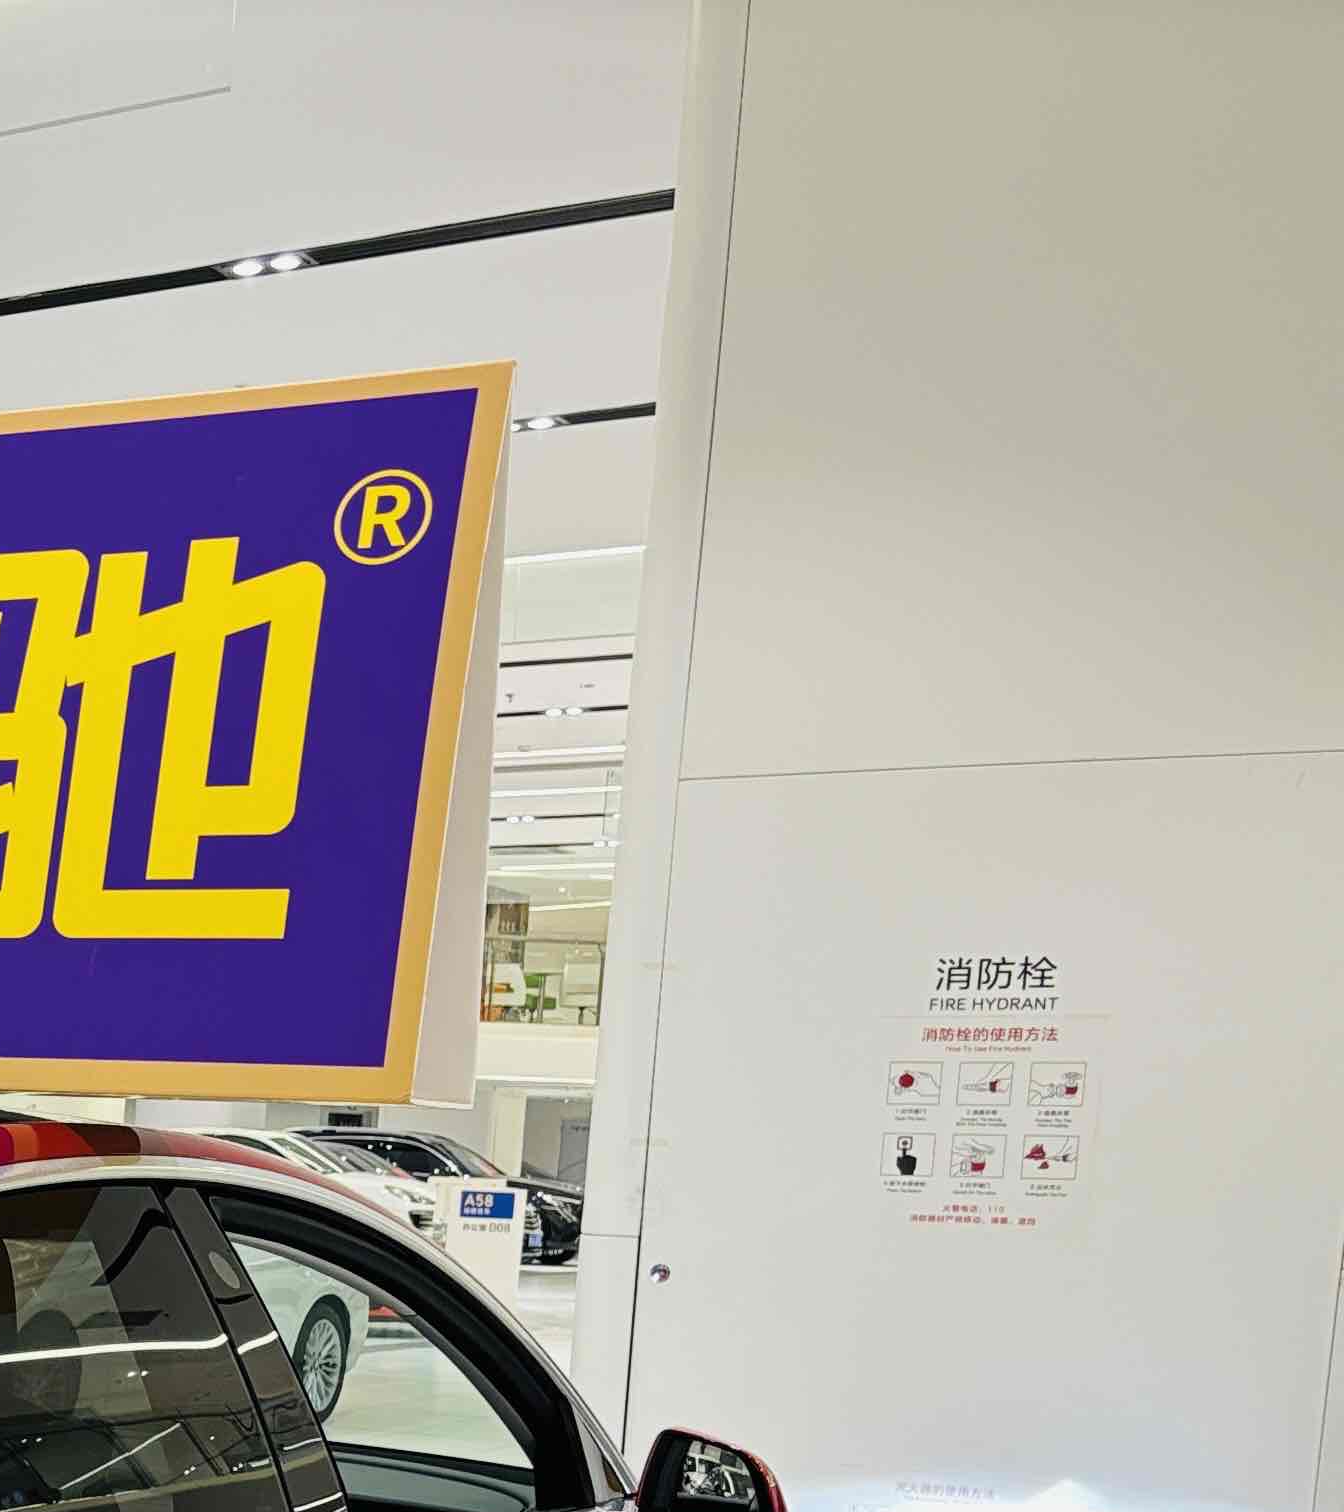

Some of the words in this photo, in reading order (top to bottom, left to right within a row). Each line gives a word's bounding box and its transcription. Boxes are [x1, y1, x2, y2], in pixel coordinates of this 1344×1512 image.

[936, 956, 1057, 990] 消防栓
[929, 997, 966, 1011] FIRE
[972, 996, 1059, 1011] HYDRANT
[922, 1027, 1059, 1042] 消防栓的使用方法
[464, 1193, 494, 1208] A58
